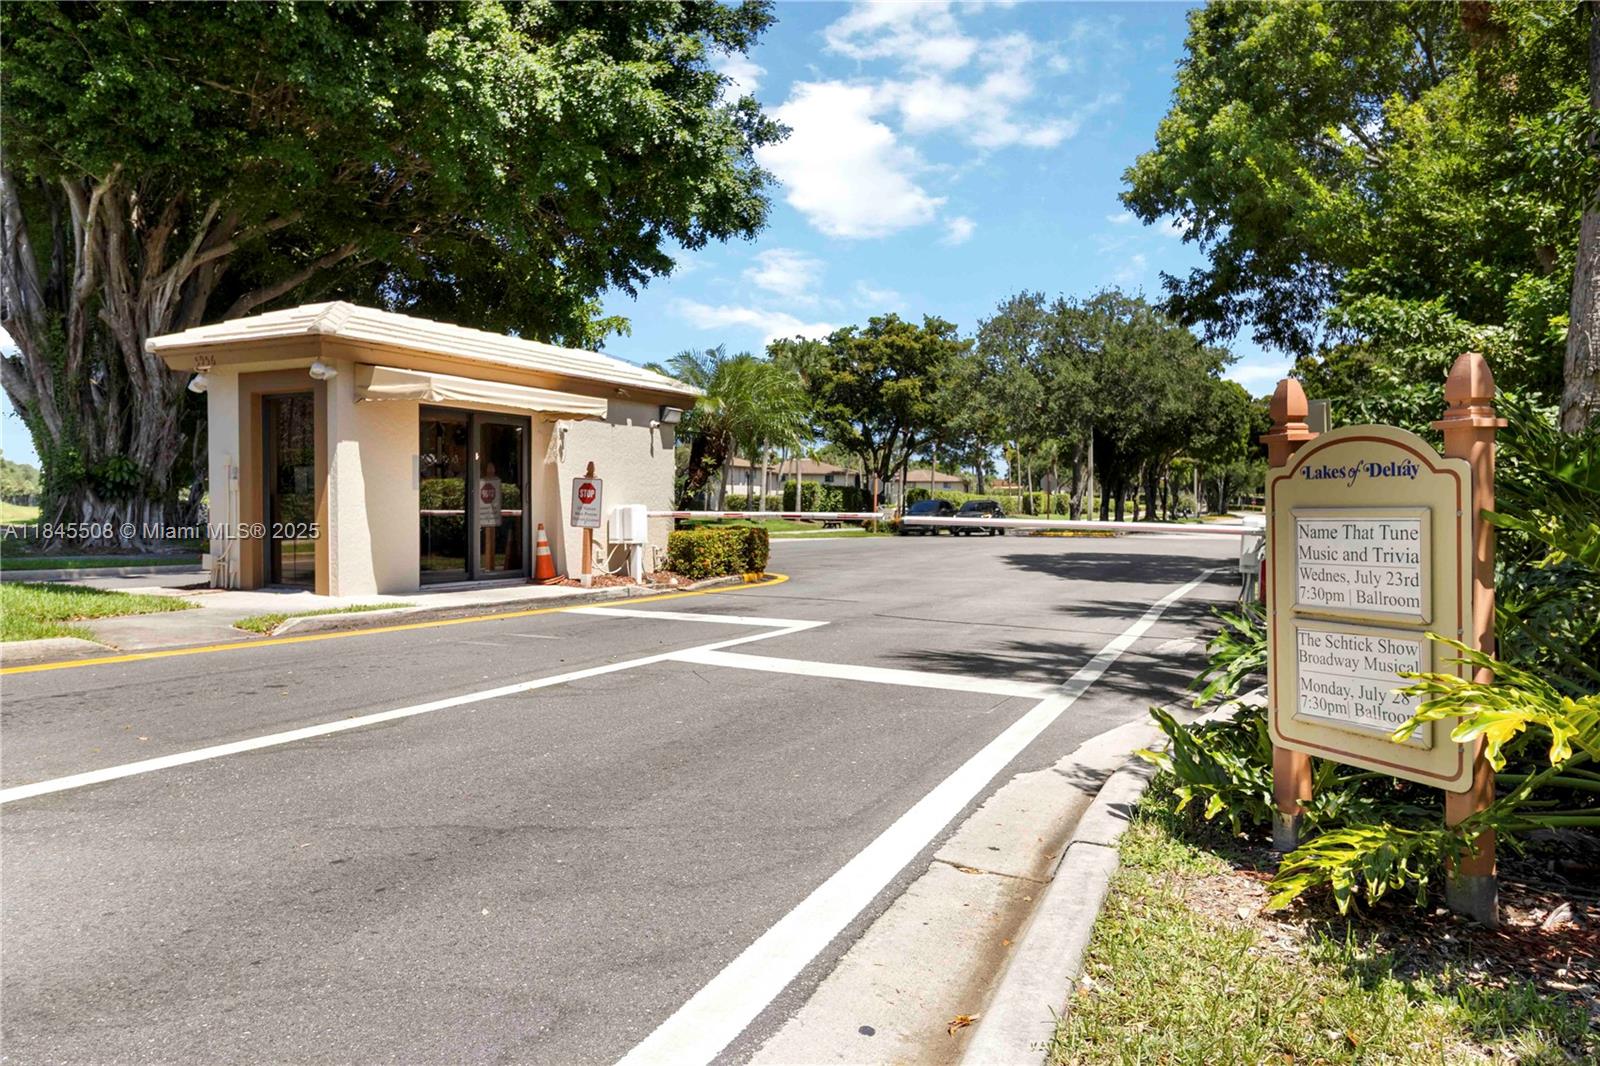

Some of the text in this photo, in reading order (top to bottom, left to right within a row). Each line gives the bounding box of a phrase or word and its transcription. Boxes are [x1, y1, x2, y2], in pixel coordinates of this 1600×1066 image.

[1300, 458, 1420, 488] Lakes of Delray
[579, 489, 595, 498] STOP
[1299, 524, 1419, 541] Name That Tune
[1299, 545, 1419, 564] Music and Trivia
[1300, 567, 1420, 588] Wednes, July 23rd
[1299, 586, 1345, 604] 7:30pm
[1356, 589, 1420, 608] Ballroom
[1298, 632, 1418, 656] The Schtick Show
[1299, 649, 1419, 673] Broadway Musical
[1301, 677, 1354, 700] Monday,
[1358, 685, 1387, 706] July
